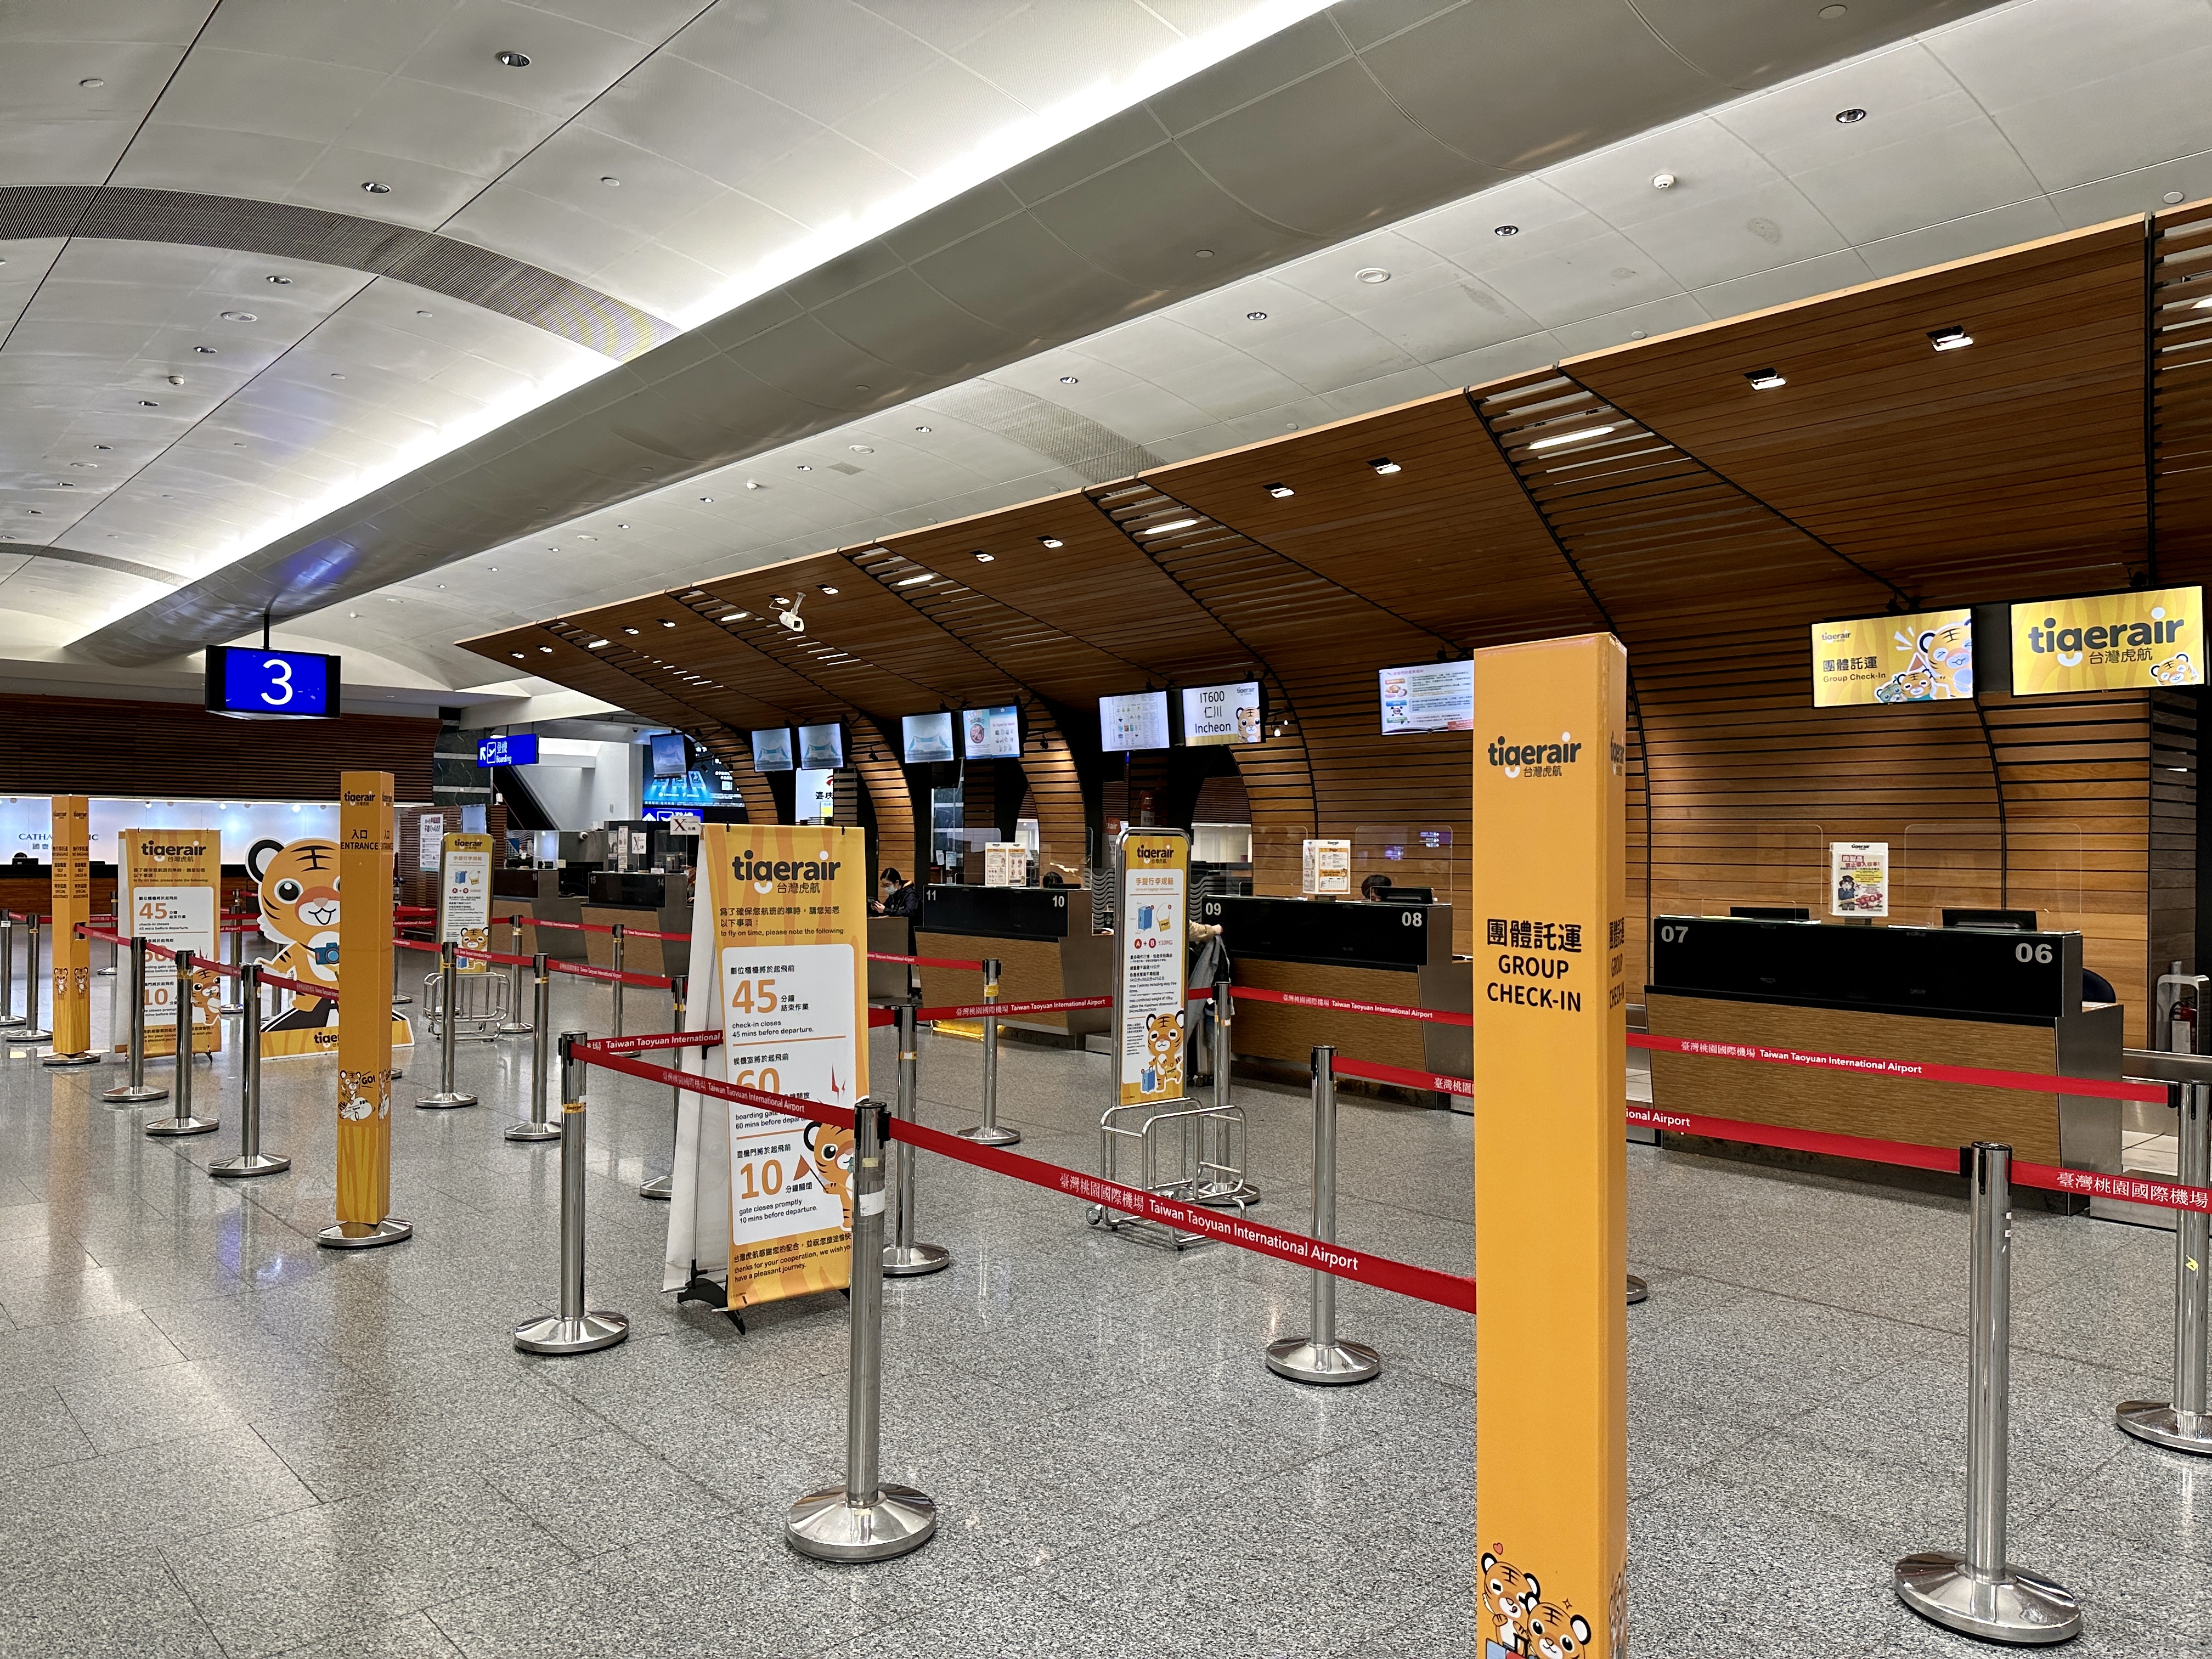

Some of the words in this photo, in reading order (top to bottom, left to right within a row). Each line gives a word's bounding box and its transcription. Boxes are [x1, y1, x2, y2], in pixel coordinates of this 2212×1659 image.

[1821, 630, 1851, 643] tigerair
[2028, 607, 2184, 667] tigerair
[2089, 647, 2153, 664] 台灣虎航
[1823, 657, 1877, 672] 團體託運
[261, 659, 293, 705] 3
[1850, 672, 1886, 681] Check-In
[1200, 691, 1224, 703] IT600
[1204, 706, 1222, 718] 仁川
[1195, 722, 1231, 733] Incheon
[496, 754, 512, 764] Boarding
[1488, 731, 1581, 778] tigerair
[1523, 765, 1562, 777] 台灣虎航
[344, 791, 375, 806] tigerair
[673, 819, 686, 831] X
[351, 830, 368, 839] 入口
[141, 840, 206, 862] tigerair
[454, 839, 483, 849] tigerair
[1137, 844, 1174, 864] tigerair
[732, 850, 840, 894] tigerair
[658, 878, 664, 887] 14
[777, 882, 820, 894] 台灣虎航
[1136, 877, 1173, 885] 手提行李規範
[927, 890, 936, 901] 11
[1052, 895, 1065, 907] 10
[139, 902, 167, 919] 45
[1205, 902, 1221, 915] 09
[1402, 912, 1422, 927] 08
[1487, 918, 1582, 952] 團體託運
[1661, 926, 1689, 943] 07
[2015, 944, 2053, 963] 06
[1498, 955, 1568, 979] GROUP
[145, 988, 168, 1006] 10
[732, 979, 777, 1014] 45
[1487, 982, 1581, 1012] CHECK-IN
[781, 1003, 809, 1012] 結束作業
[1031, 1003, 1053, 1012] Taoyuan
[1087, 998, 1105, 1007] Airport
[1331, 1000, 1350, 1008] Taiwan
[1351, 1002, 1374, 1012] Taoyuan
[1374, 1005, 1410, 1015] International
[1411, 1010, 1433, 1018] Airport
[780, 1026, 814, 1034] departure.
[314, 1032, 338, 1048] tige
[606, 1041, 635, 1049] Taiwan
[636, 1037, 669, 1047] Taoyuan
[672, 1032, 720, 1043] International
[1681, 1041, 1756, 1058] 臺灣桃園國際機場
[1759, 1048, 1789, 1060] Taiwan
[1791, 1051, 1827, 1064] Taoyuan
[1829, 1056, 1886, 1070] International
[1887, 1062, 1922, 1075] Airport
[362, 1075, 375, 1085] GO!
[736, 1068, 780, 1094] 60
[1434, 1077, 1475, 1094] 臺灣桃園
[708, 1082, 726, 1094] Taiwan
[726, 1086, 748, 1100] Taoyuan
[749, 1092, 783, 1108] International
[784, 1099, 805, 1113] Airport
[736, 1111, 763, 1120] boarding
[1652, 1113, 1691, 1127] Airport
[741, 1159, 783, 1199] 10
[2057, 1172, 2209, 1209] 臺灣桃園國際機場
[739, 1207, 752, 1216] gate
[775, 1198, 803, 1209] promptly
[764, 1210, 787, 1219] before
[786, 1205, 818, 1216] departure.
[1059, 1173, 1144, 1212] 臺灣桃園國際機場
[1149, 1198, 1184, 1222] Taiwan
[1187, 1209, 1231, 1235] Taoyuan
[1234, 1223, 1308, 1256] International
[1311, 1244, 1358, 1271] Airport
[735, 1263, 753, 1273] thanks
[754, 1261, 763, 1269] for
[764, 1259, 778, 1268] your
[780, 1252, 819, 1264] cooperation,
[830, 1245, 843, 1254] wish
[735, 1274, 748, 1283] have
[754, 1266, 781, 1279] pleasant
[782, 1262, 806, 1273] journey.
